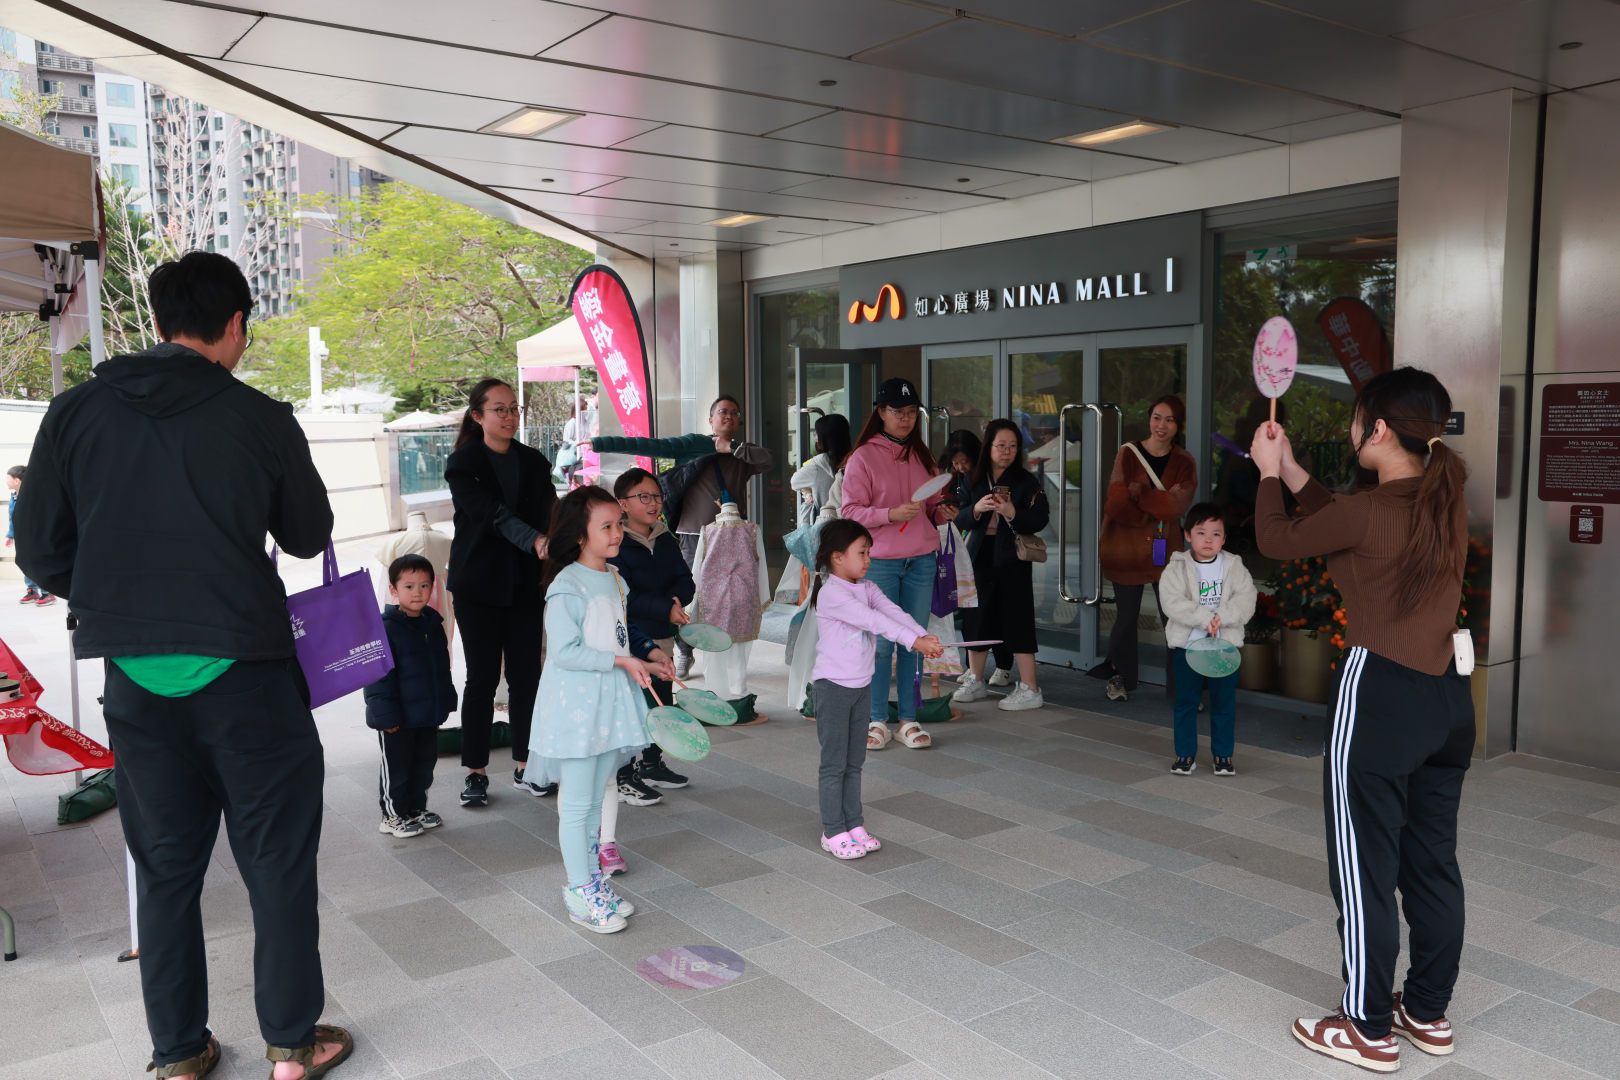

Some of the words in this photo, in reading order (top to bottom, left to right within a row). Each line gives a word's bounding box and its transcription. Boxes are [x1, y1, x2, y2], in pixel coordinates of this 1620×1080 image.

[914, 288, 990, 317] 如心廣場
[1002, 281, 1061, 309] NINA
[1075, 272, 1148, 301] MALL
[1595, 440, 1614, 448] Wang
